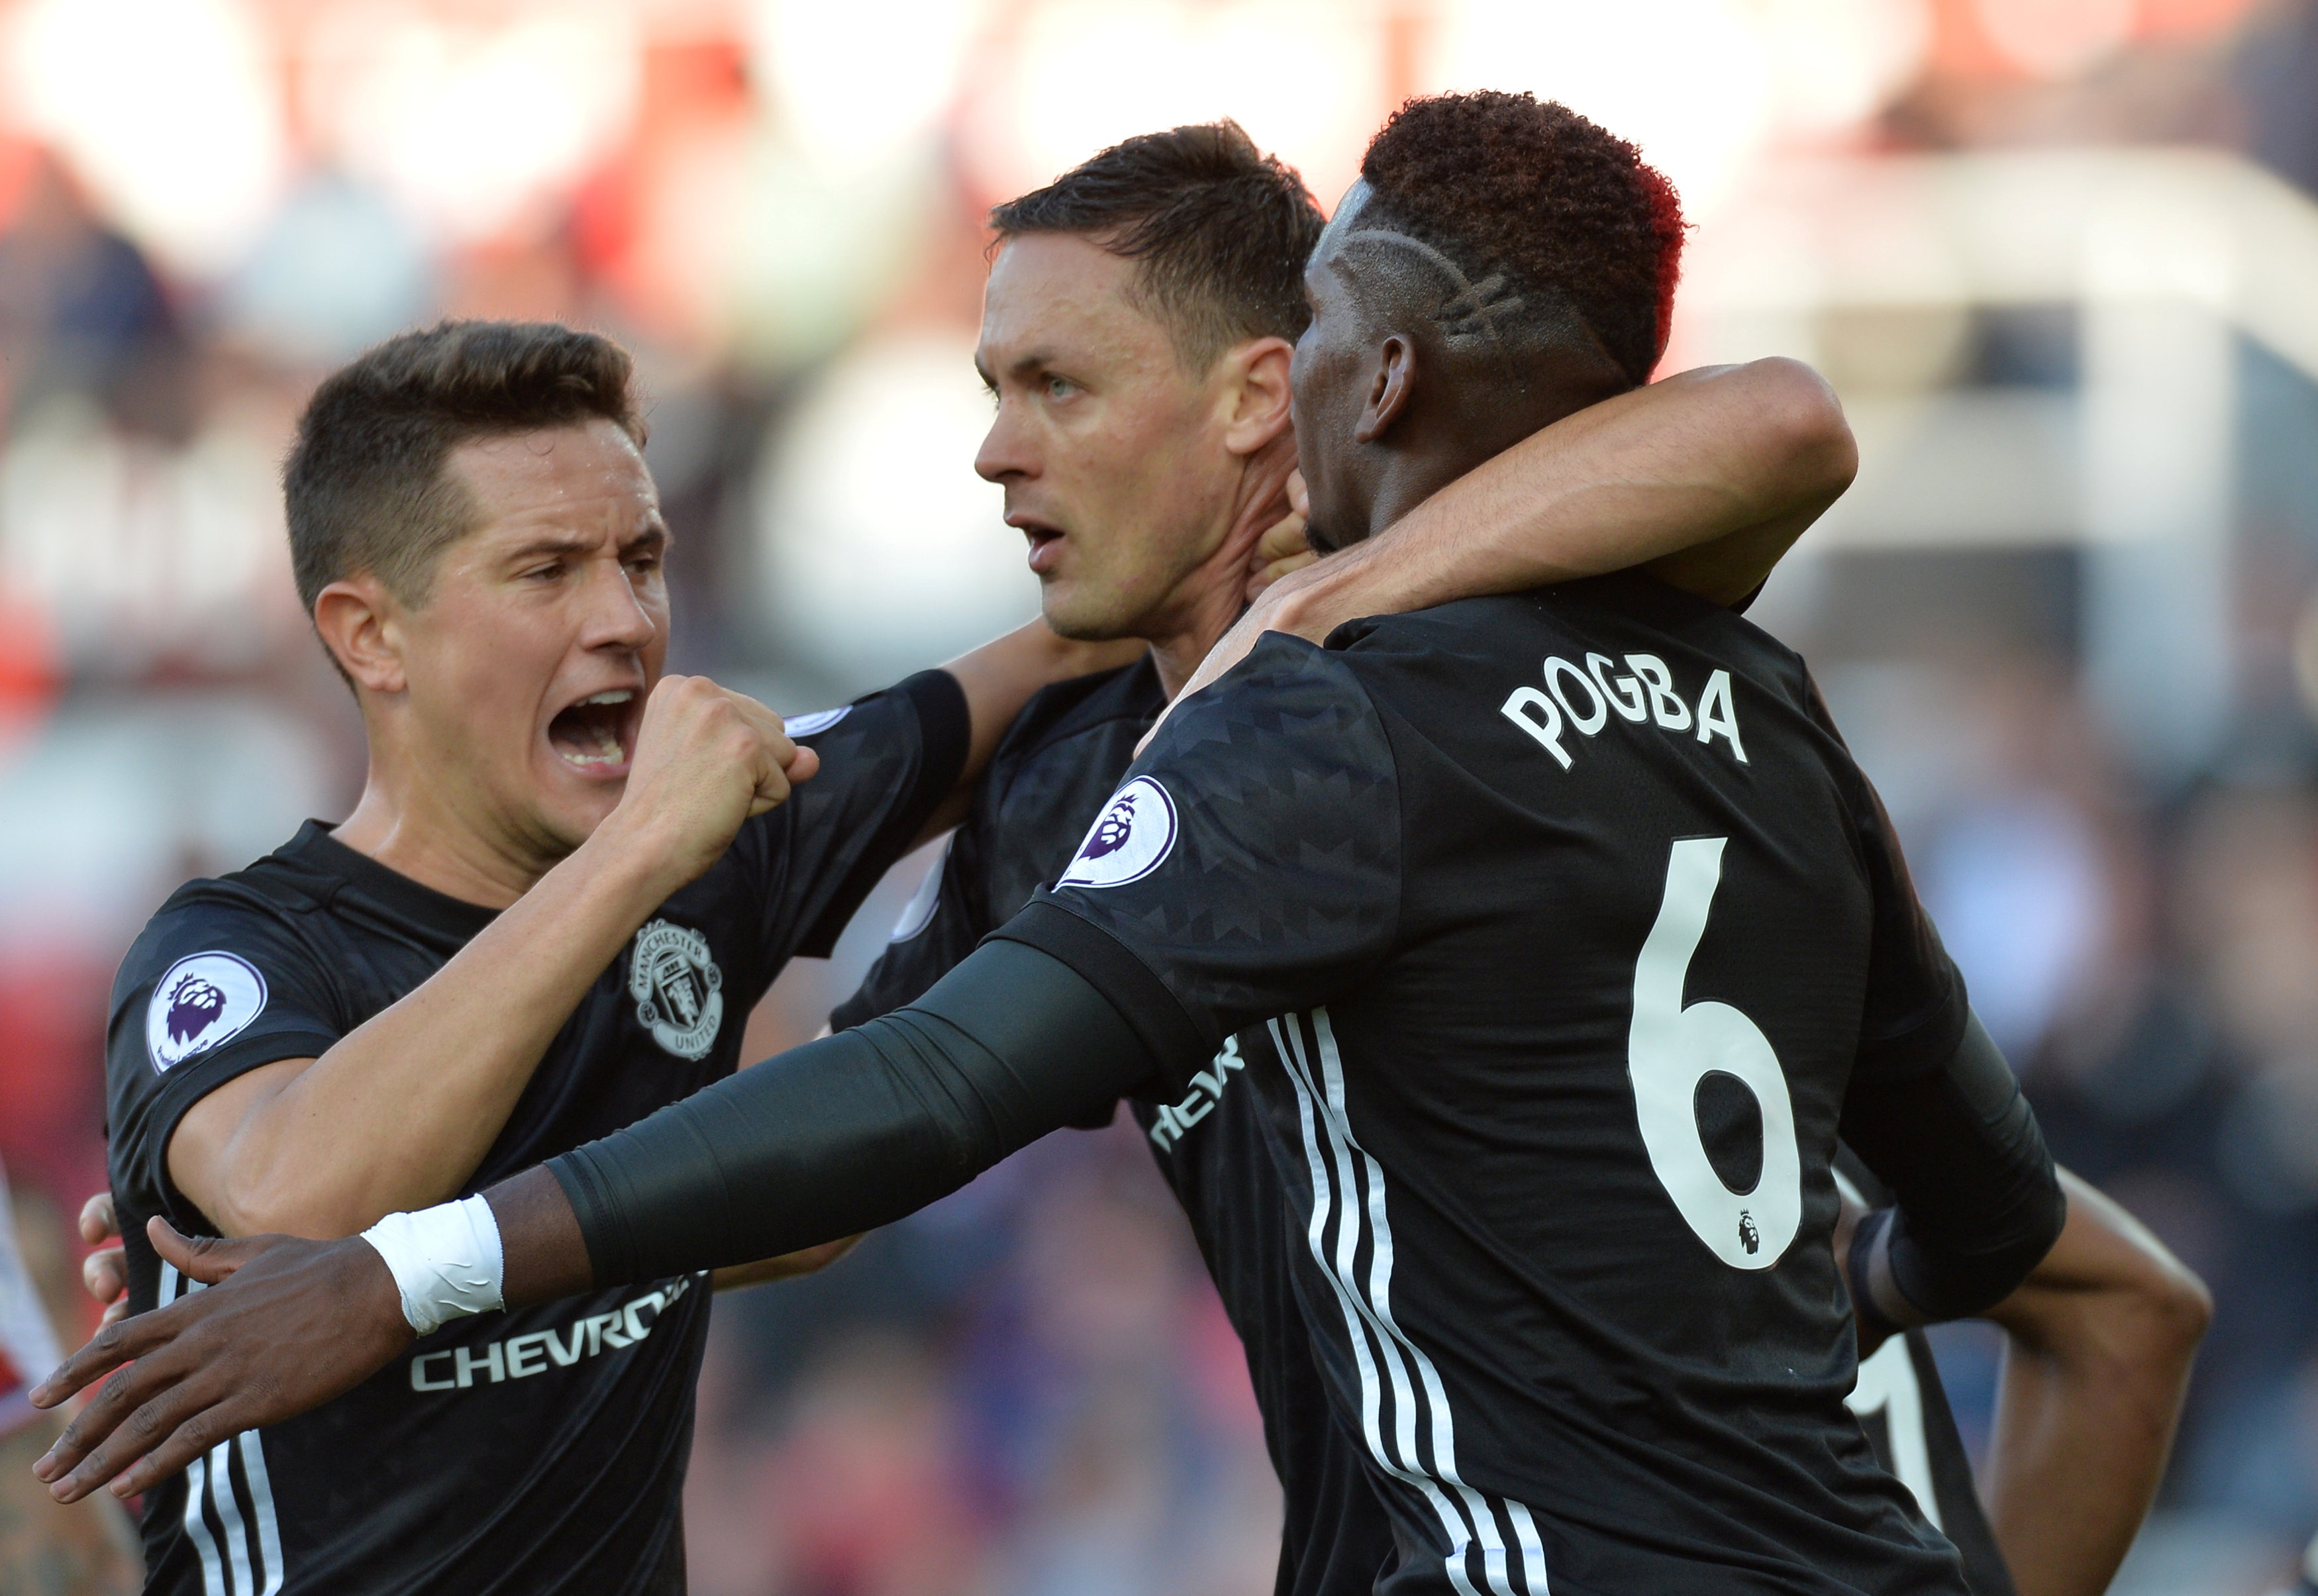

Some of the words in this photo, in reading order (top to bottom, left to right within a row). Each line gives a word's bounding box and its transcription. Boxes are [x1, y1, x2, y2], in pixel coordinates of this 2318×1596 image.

[1499, 651, 1748, 770] POGBA
[637, 932, 703, 989] MANCHESTER
[675, 1015, 717, 1050] UNITED
[1628, 836, 1801, 1270] 6
[411, 1270, 709, 1392] CHEVRO
